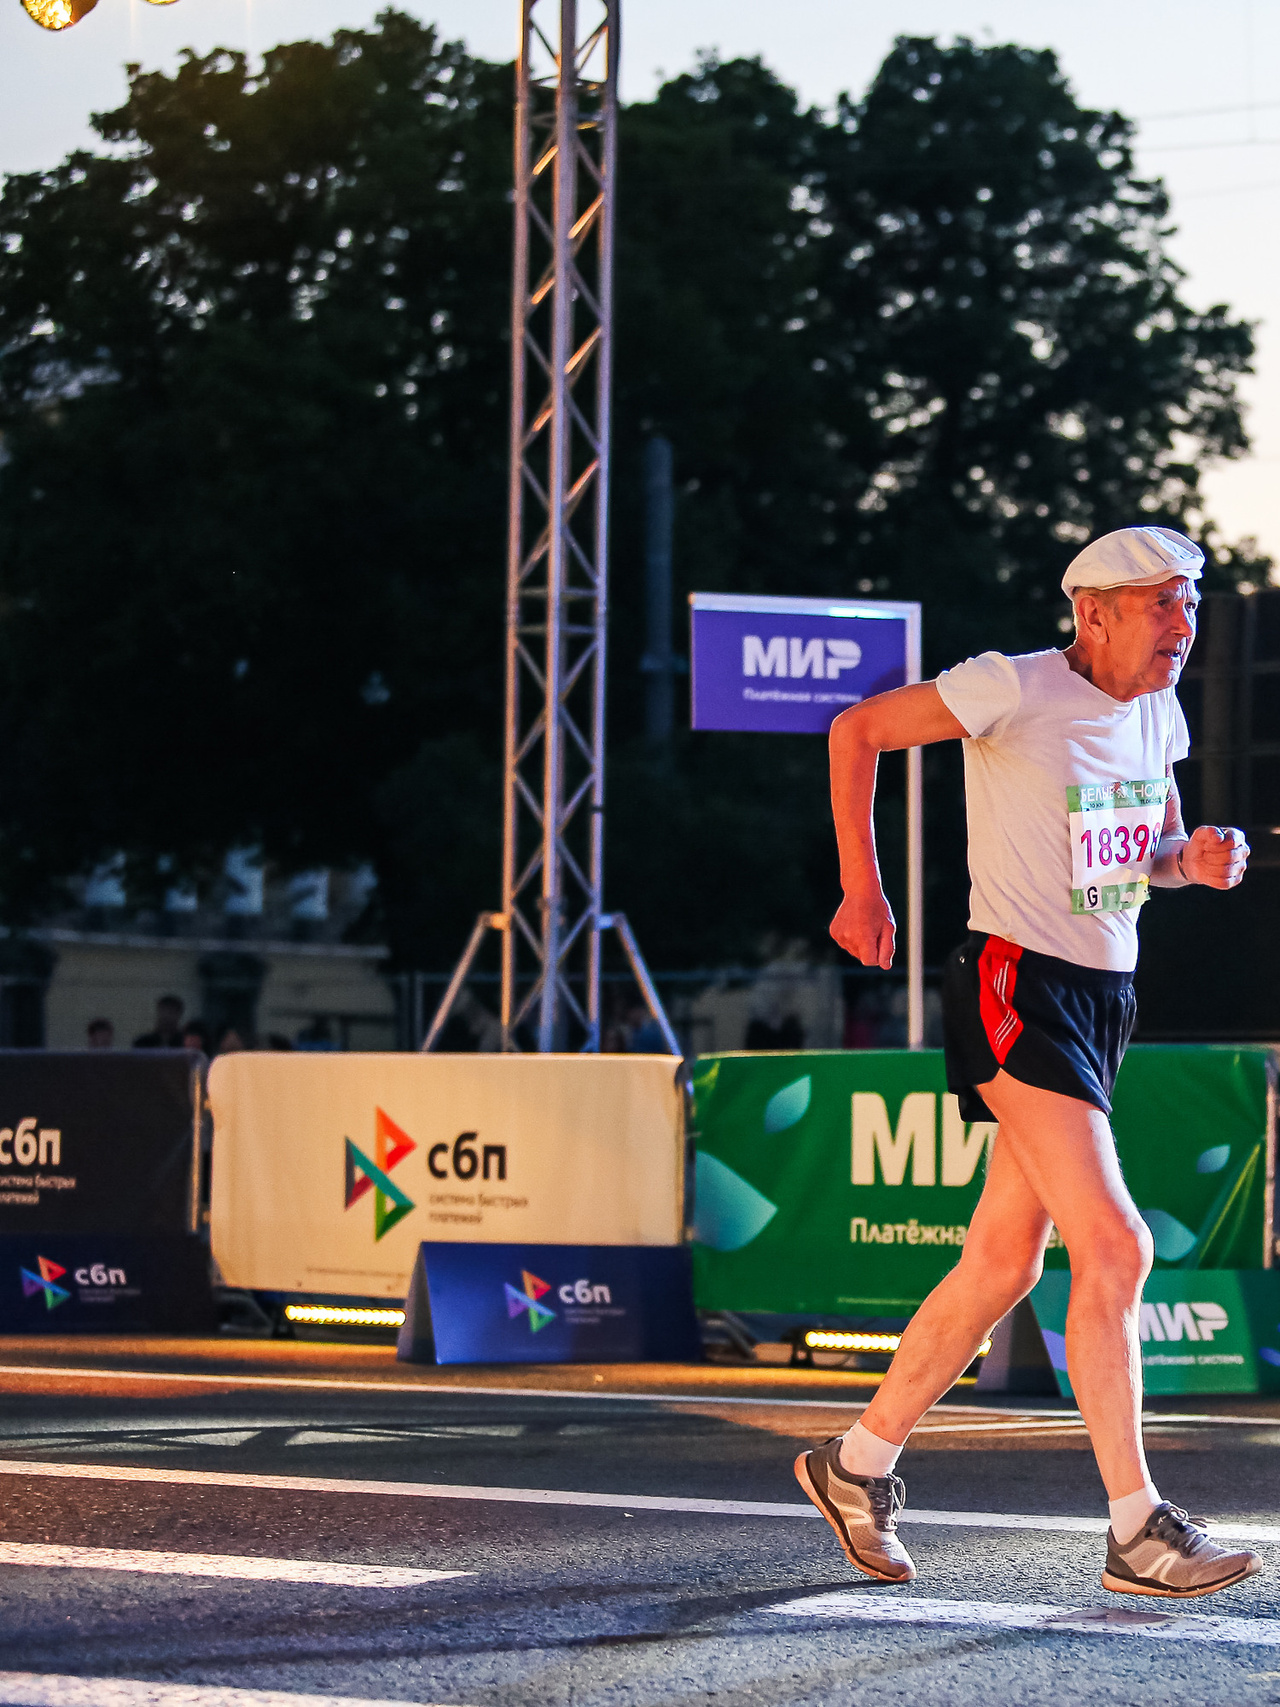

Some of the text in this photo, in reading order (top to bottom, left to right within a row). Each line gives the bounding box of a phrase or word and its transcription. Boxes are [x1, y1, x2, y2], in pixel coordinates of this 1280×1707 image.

[742, 635, 862, 680] МИР
[1087, 886, 1098, 907] G
[851, 1091, 999, 1187] МИ
[428, 1130, 507, 1181] сбп
[851, 1217, 968, 1246] Платёжна
[75, 1263, 127, 1285] сбп
[558, 1279, 612, 1304] сбп
